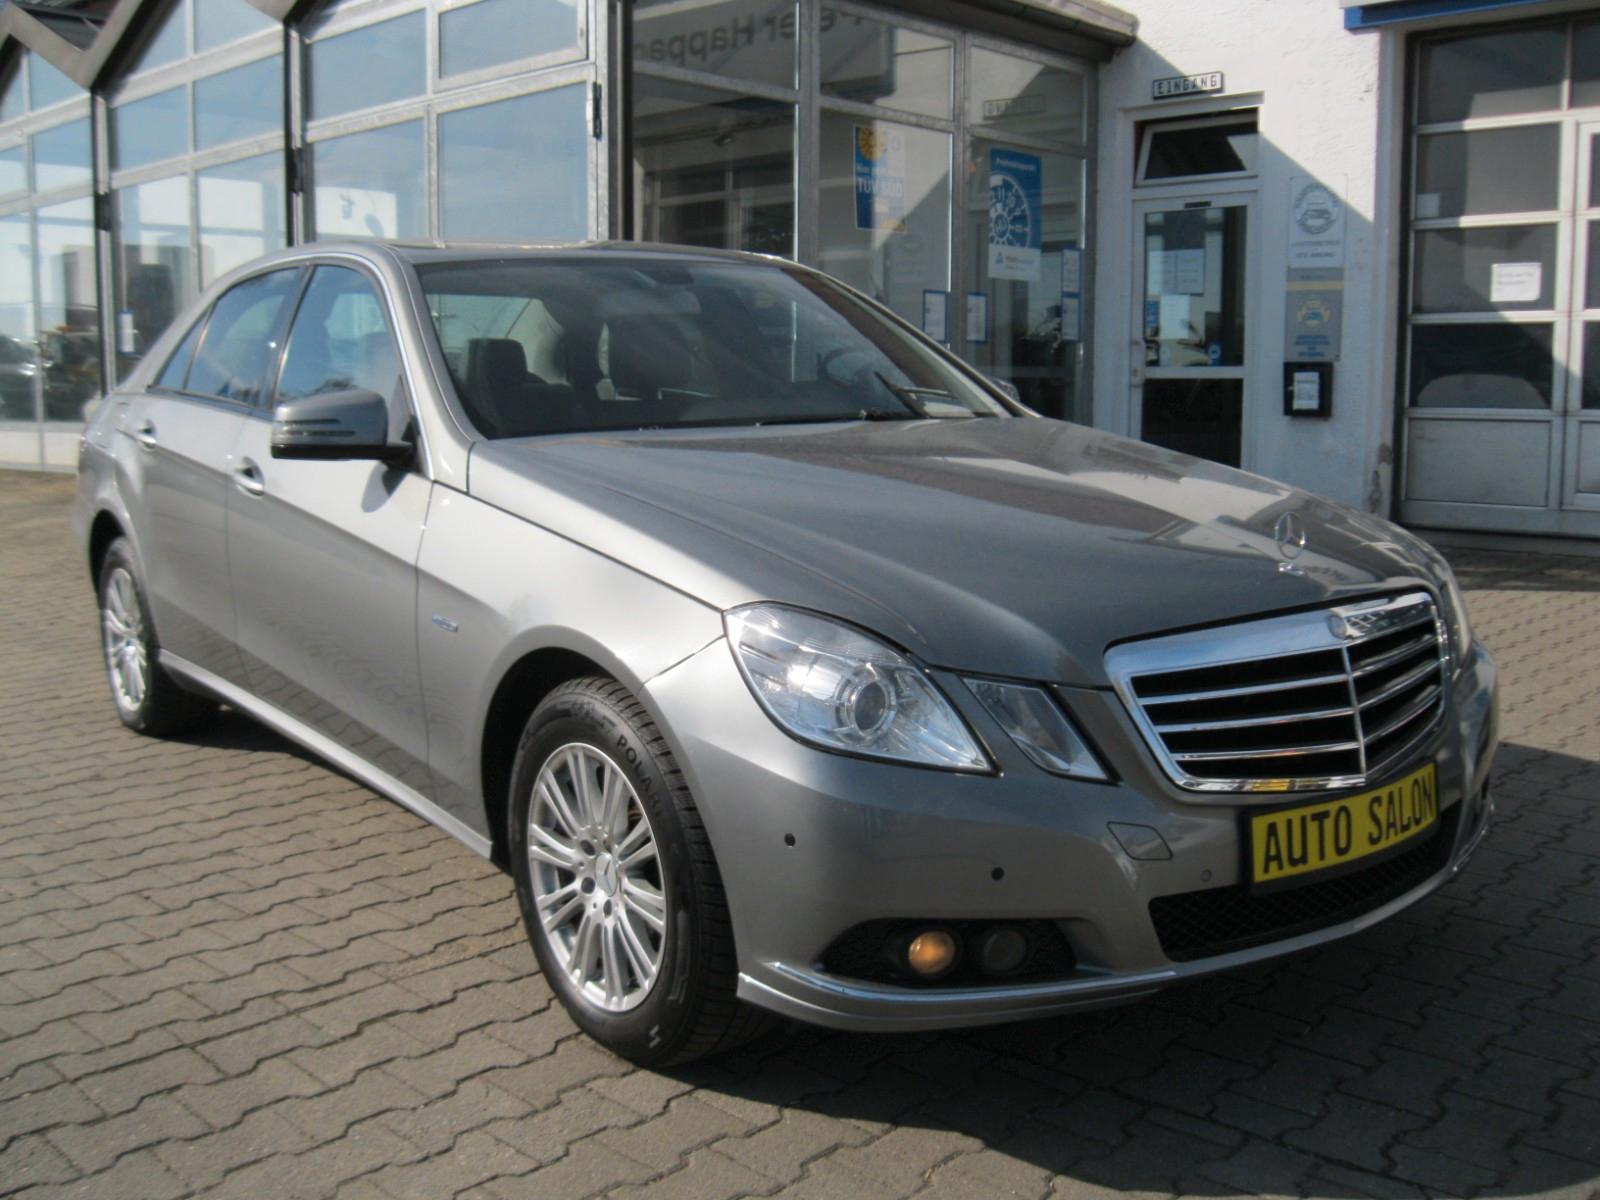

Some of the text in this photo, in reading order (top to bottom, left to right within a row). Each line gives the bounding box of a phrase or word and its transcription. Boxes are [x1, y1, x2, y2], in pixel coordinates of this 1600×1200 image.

[1157, 74, 1217, 95] EINGANG
[1264, 770, 1435, 874] AUTO SALON
